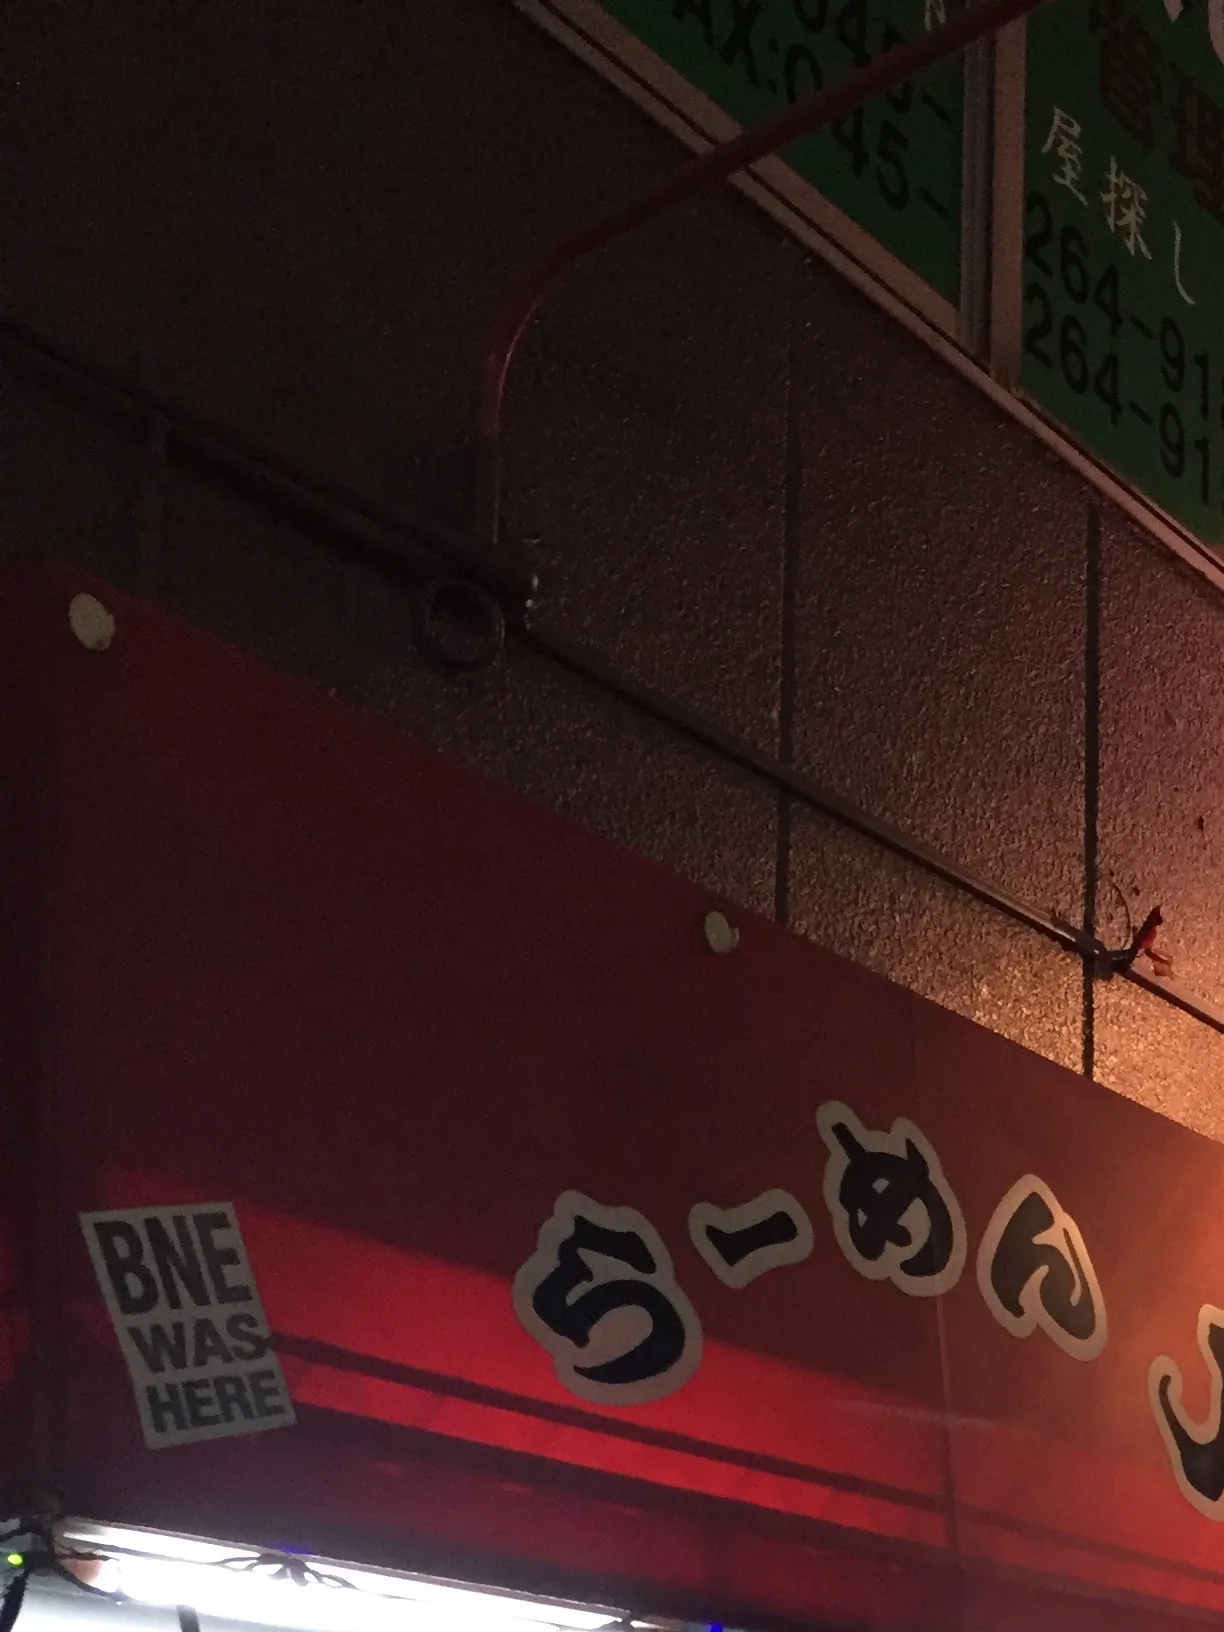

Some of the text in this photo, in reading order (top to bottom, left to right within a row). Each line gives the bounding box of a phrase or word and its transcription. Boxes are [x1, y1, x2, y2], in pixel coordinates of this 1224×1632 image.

[94, 1212, 253, 1315] BNE
[127, 1312, 273, 1374] WAS
[145, 1370, 286, 1434] HERE
